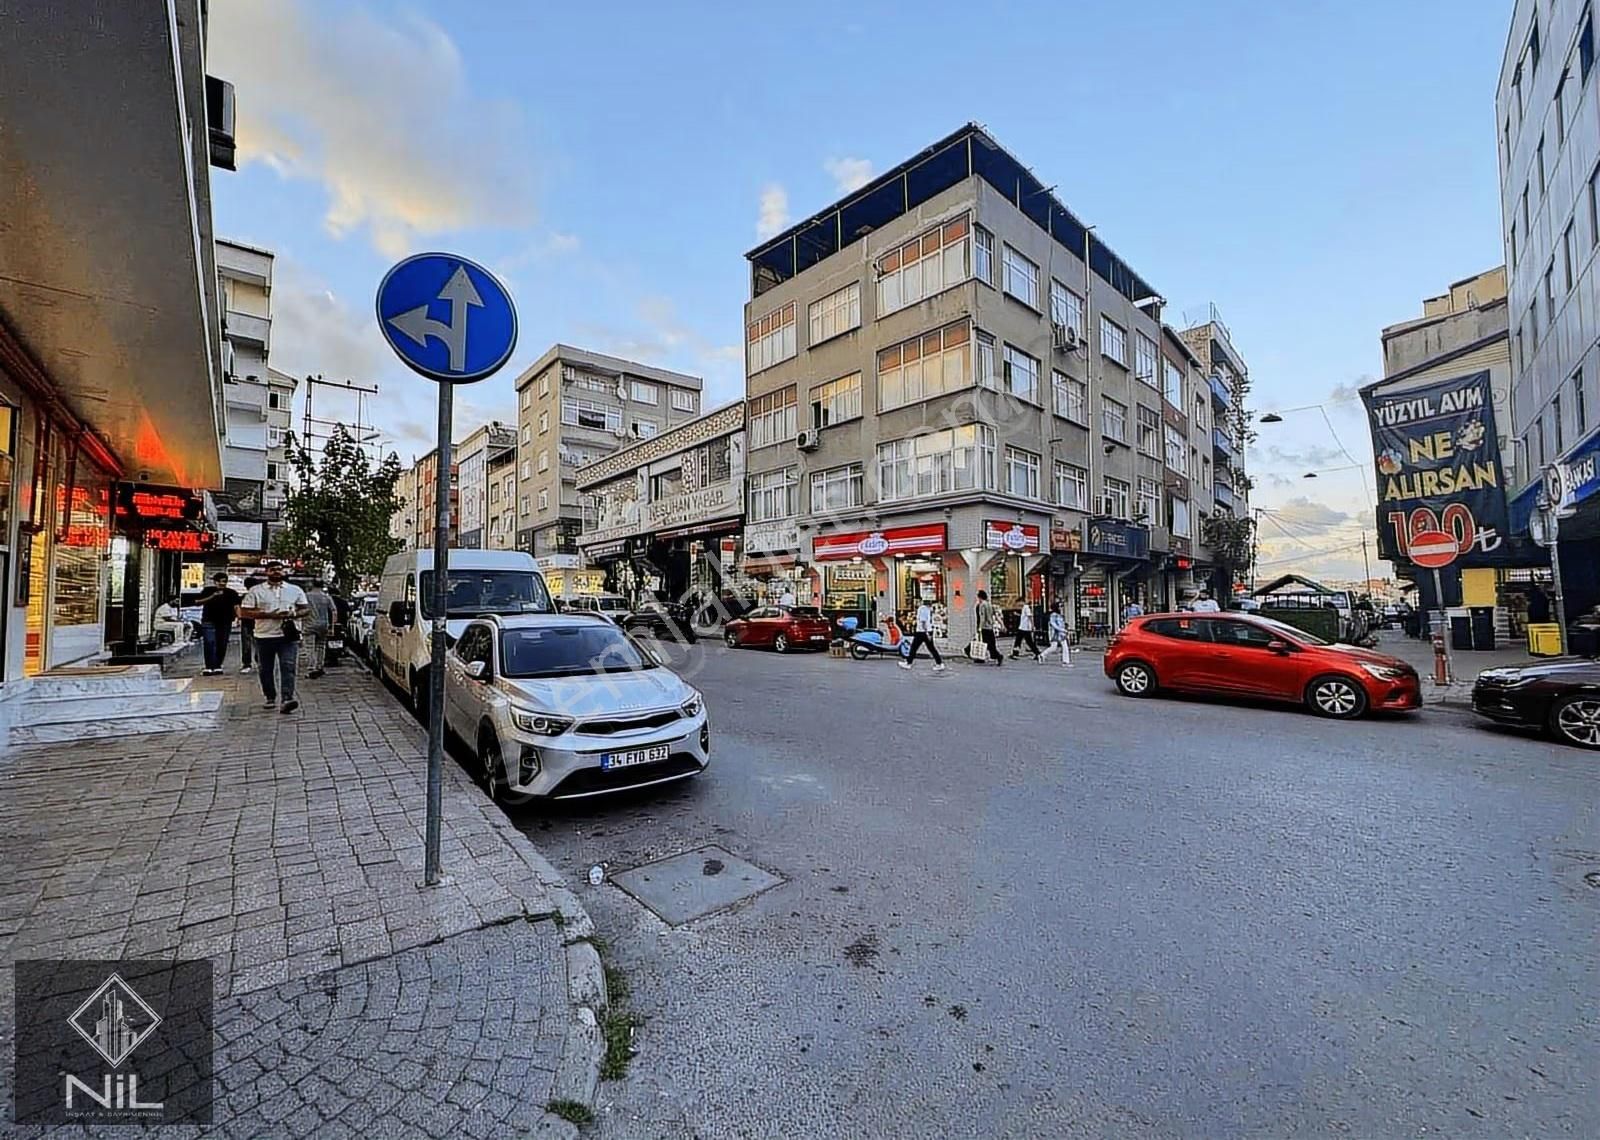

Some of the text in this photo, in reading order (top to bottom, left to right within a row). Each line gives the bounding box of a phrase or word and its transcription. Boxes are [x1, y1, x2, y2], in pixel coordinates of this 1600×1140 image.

[1374, 387, 1484, 427] YÜZYIL AVM
[1409, 433, 1454, 462] NE
[1385, 464, 1495, 501] ALIRSAN
[609, 755, 622, 767] 34
[648, 747, 666, 760] 632
